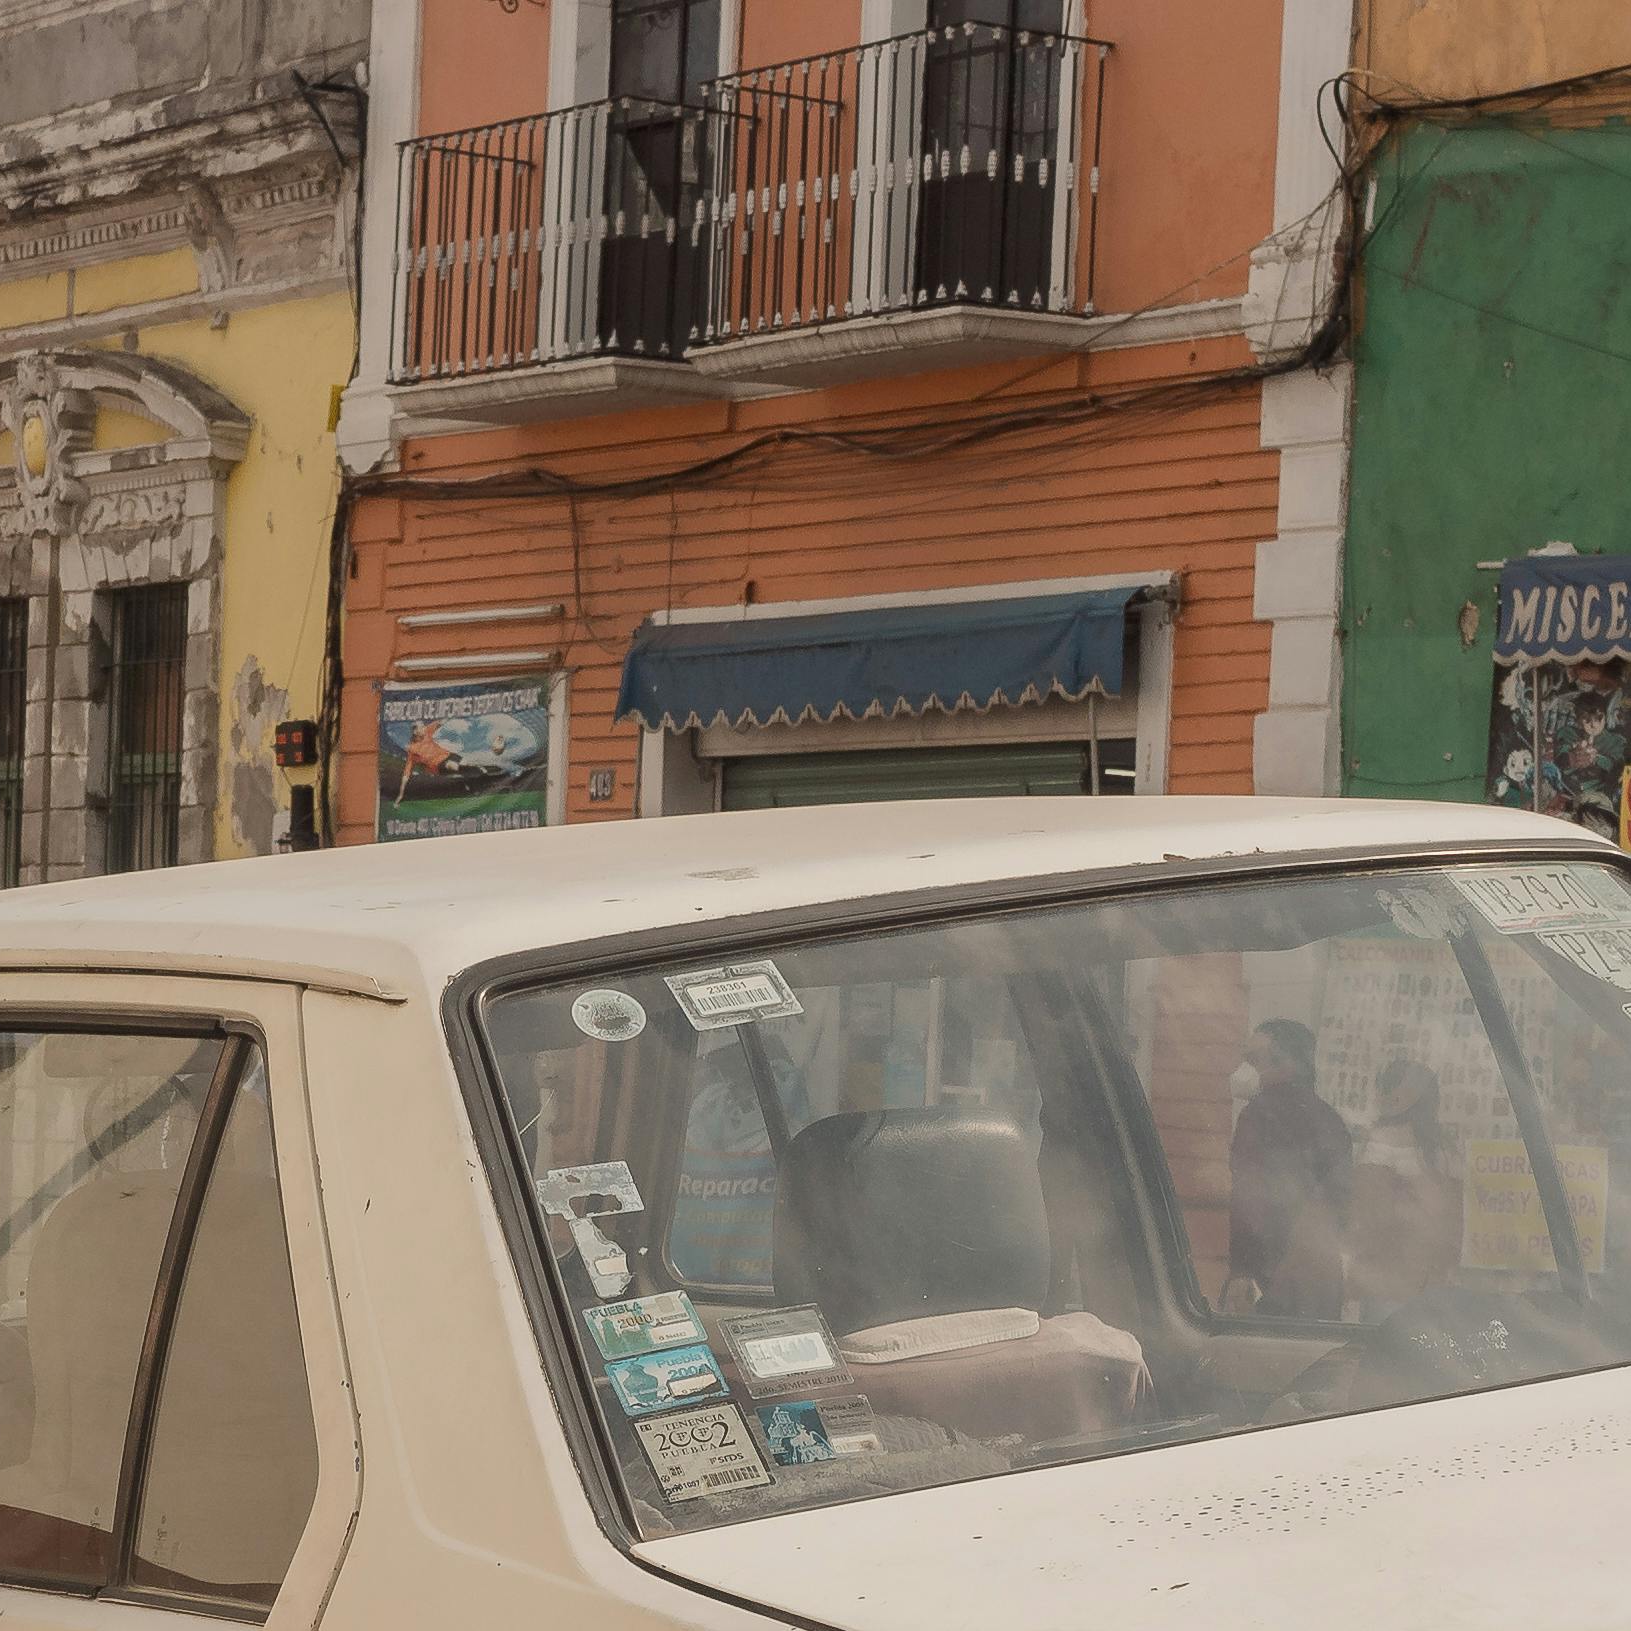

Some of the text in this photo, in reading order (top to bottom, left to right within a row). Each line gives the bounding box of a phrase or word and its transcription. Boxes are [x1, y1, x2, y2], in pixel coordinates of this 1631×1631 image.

[1459, 873, 1600, 916] TVB-79-70
[677, 1172, 776, 1201] Reparac
[590, 1300, 643, 1319] PUEBLA
[618, 1313, 653, 1330] 2000
[656, 1351, 704, 1369] Puebla
[779, 1378, 823, 1392] SEMESTRE
[663, 1413, 725, 1431] TENENCIA
[661, 1442, 718, 1460] PUEBLA
